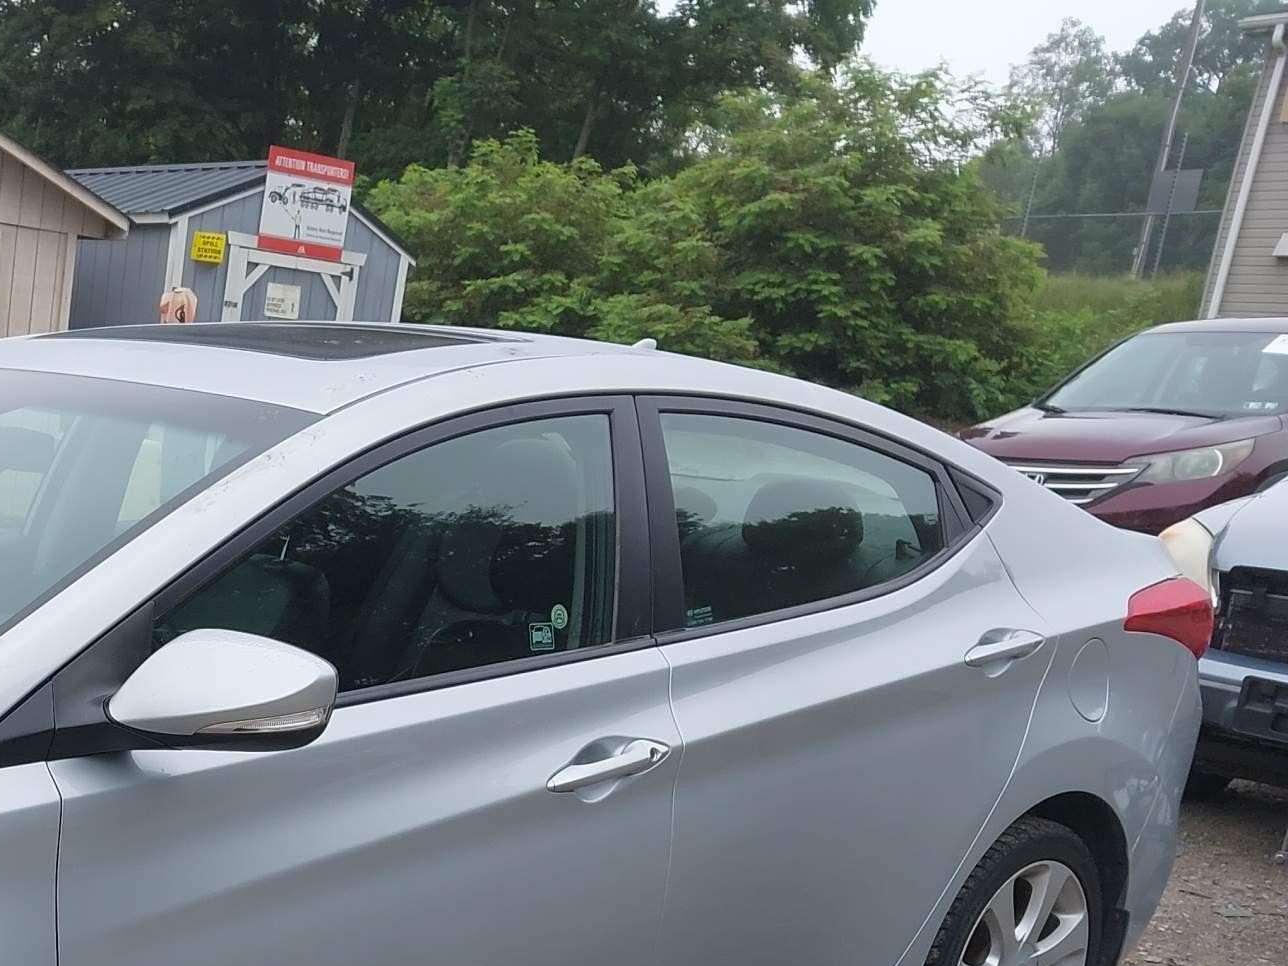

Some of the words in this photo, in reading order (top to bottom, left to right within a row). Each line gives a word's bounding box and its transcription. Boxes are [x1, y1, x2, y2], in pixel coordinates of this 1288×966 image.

[275, 155, 306, 171] ATTENTION
[202, 240, 218, 248] SPILL
[197, 247, 221, 255] STATION
